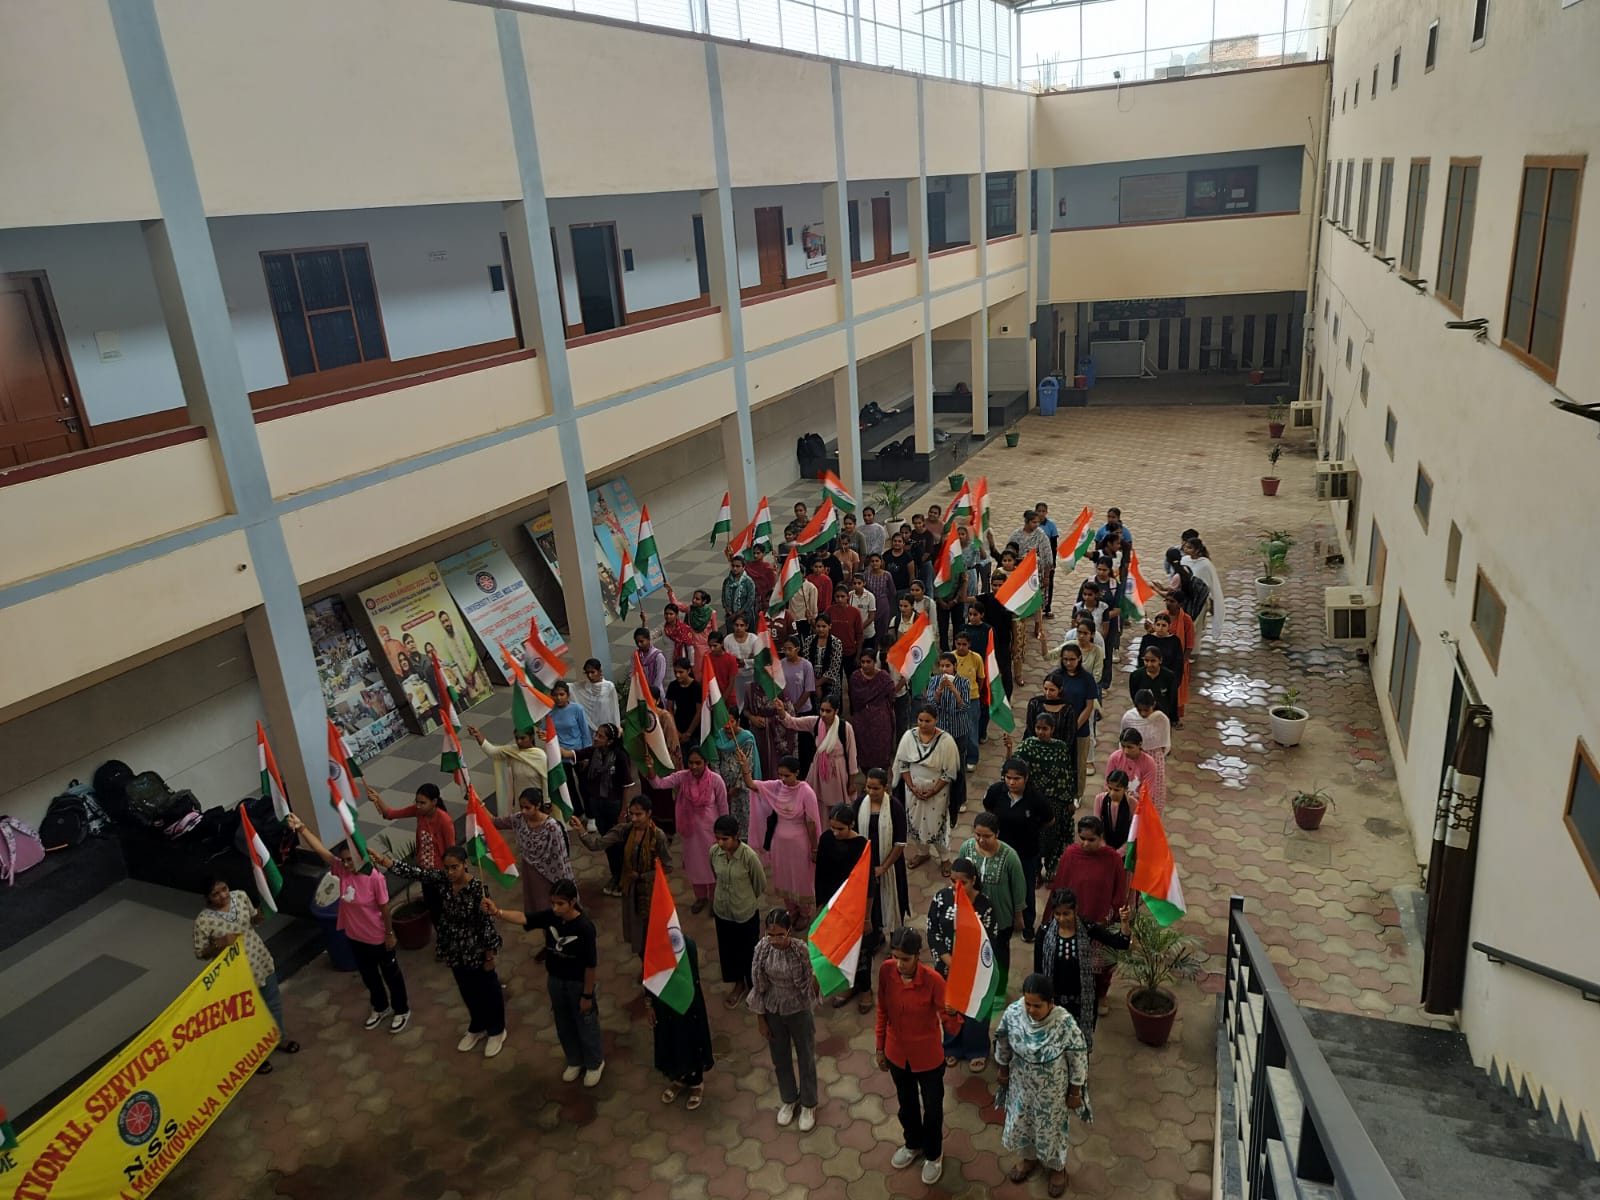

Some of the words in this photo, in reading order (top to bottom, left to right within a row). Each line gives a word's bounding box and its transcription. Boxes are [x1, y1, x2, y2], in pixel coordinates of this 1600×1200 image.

[202, 963, 221, 991] BUT
[223, 942, 240, 968] YOU
[85, 1038, 170, 1124] SERVICE
[171, 990, 255, 1051] SCHEME
